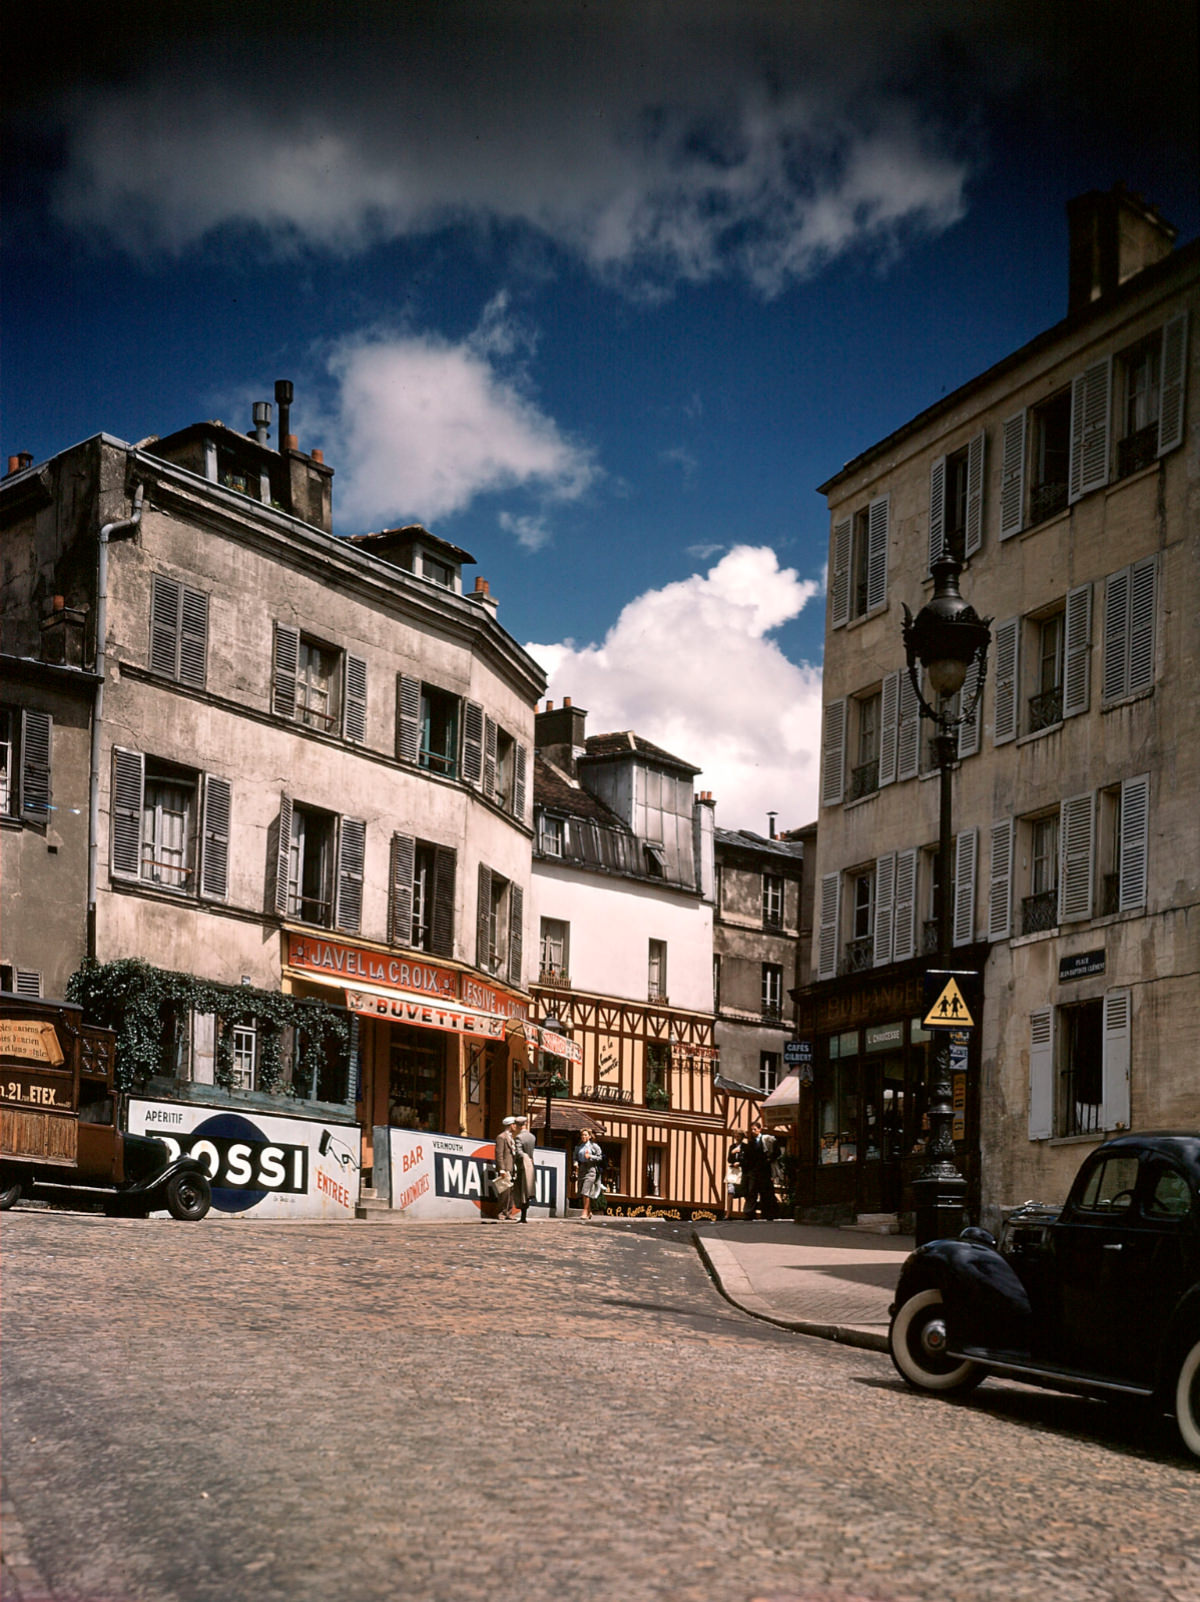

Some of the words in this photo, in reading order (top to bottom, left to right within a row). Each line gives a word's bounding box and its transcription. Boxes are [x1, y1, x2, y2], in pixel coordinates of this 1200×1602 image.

[311, 944, 366, 976] JAVEL
[369, 961, 385, 981] LA
[388, 961, 440, 992] CROIX
[463, 979, 496, 1013] LESSIVE
[376, 999, 474, 1031] BUVETTE
[30, 1085, 56, 1105] ETEX
[145, 1109, 183, 1124] APÉRITIF
[402, 1145, 424, 1174] BAR
[432, 1140, 463, 1152] VERMOUTH
[317, 1171, 349, 1209] ENTRÉE
[400, 1173, 430, 1209] SANDWICHES
